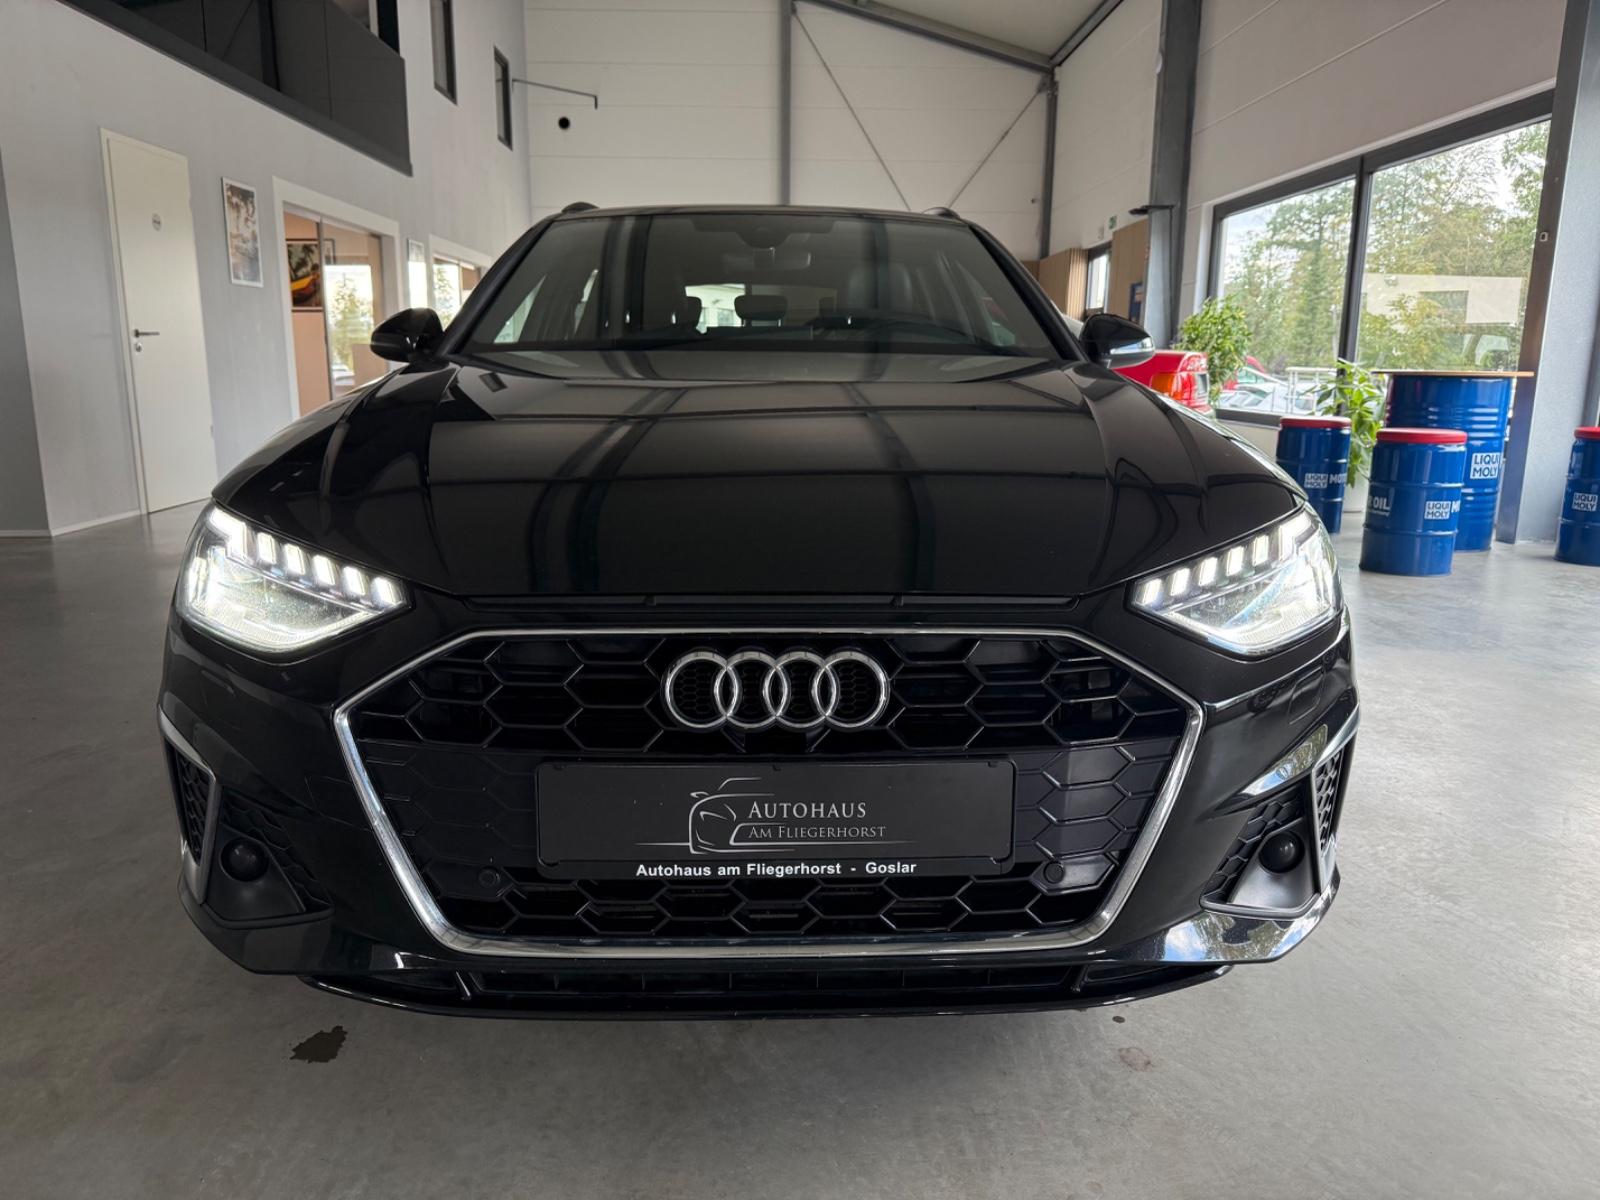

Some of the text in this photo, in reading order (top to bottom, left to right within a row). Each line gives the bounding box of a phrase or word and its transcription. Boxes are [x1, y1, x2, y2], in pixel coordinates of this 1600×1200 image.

[1472, 466, 1497, 477] MOLY
[1373, 496, 1391, 510] OIL
[1427, 502, 1450, 511] LIQUI
[748, 800, 867, 819] AUTOHAUS
[748, 825, 886, 839] AM FLIEGERHORST
[636, 864, 712, 877] Autohaus
[717, 866, 740, 876] am
[746, 862, 842, 878] Fliegerhorst
[865, 861, 917, 874] Goslar
